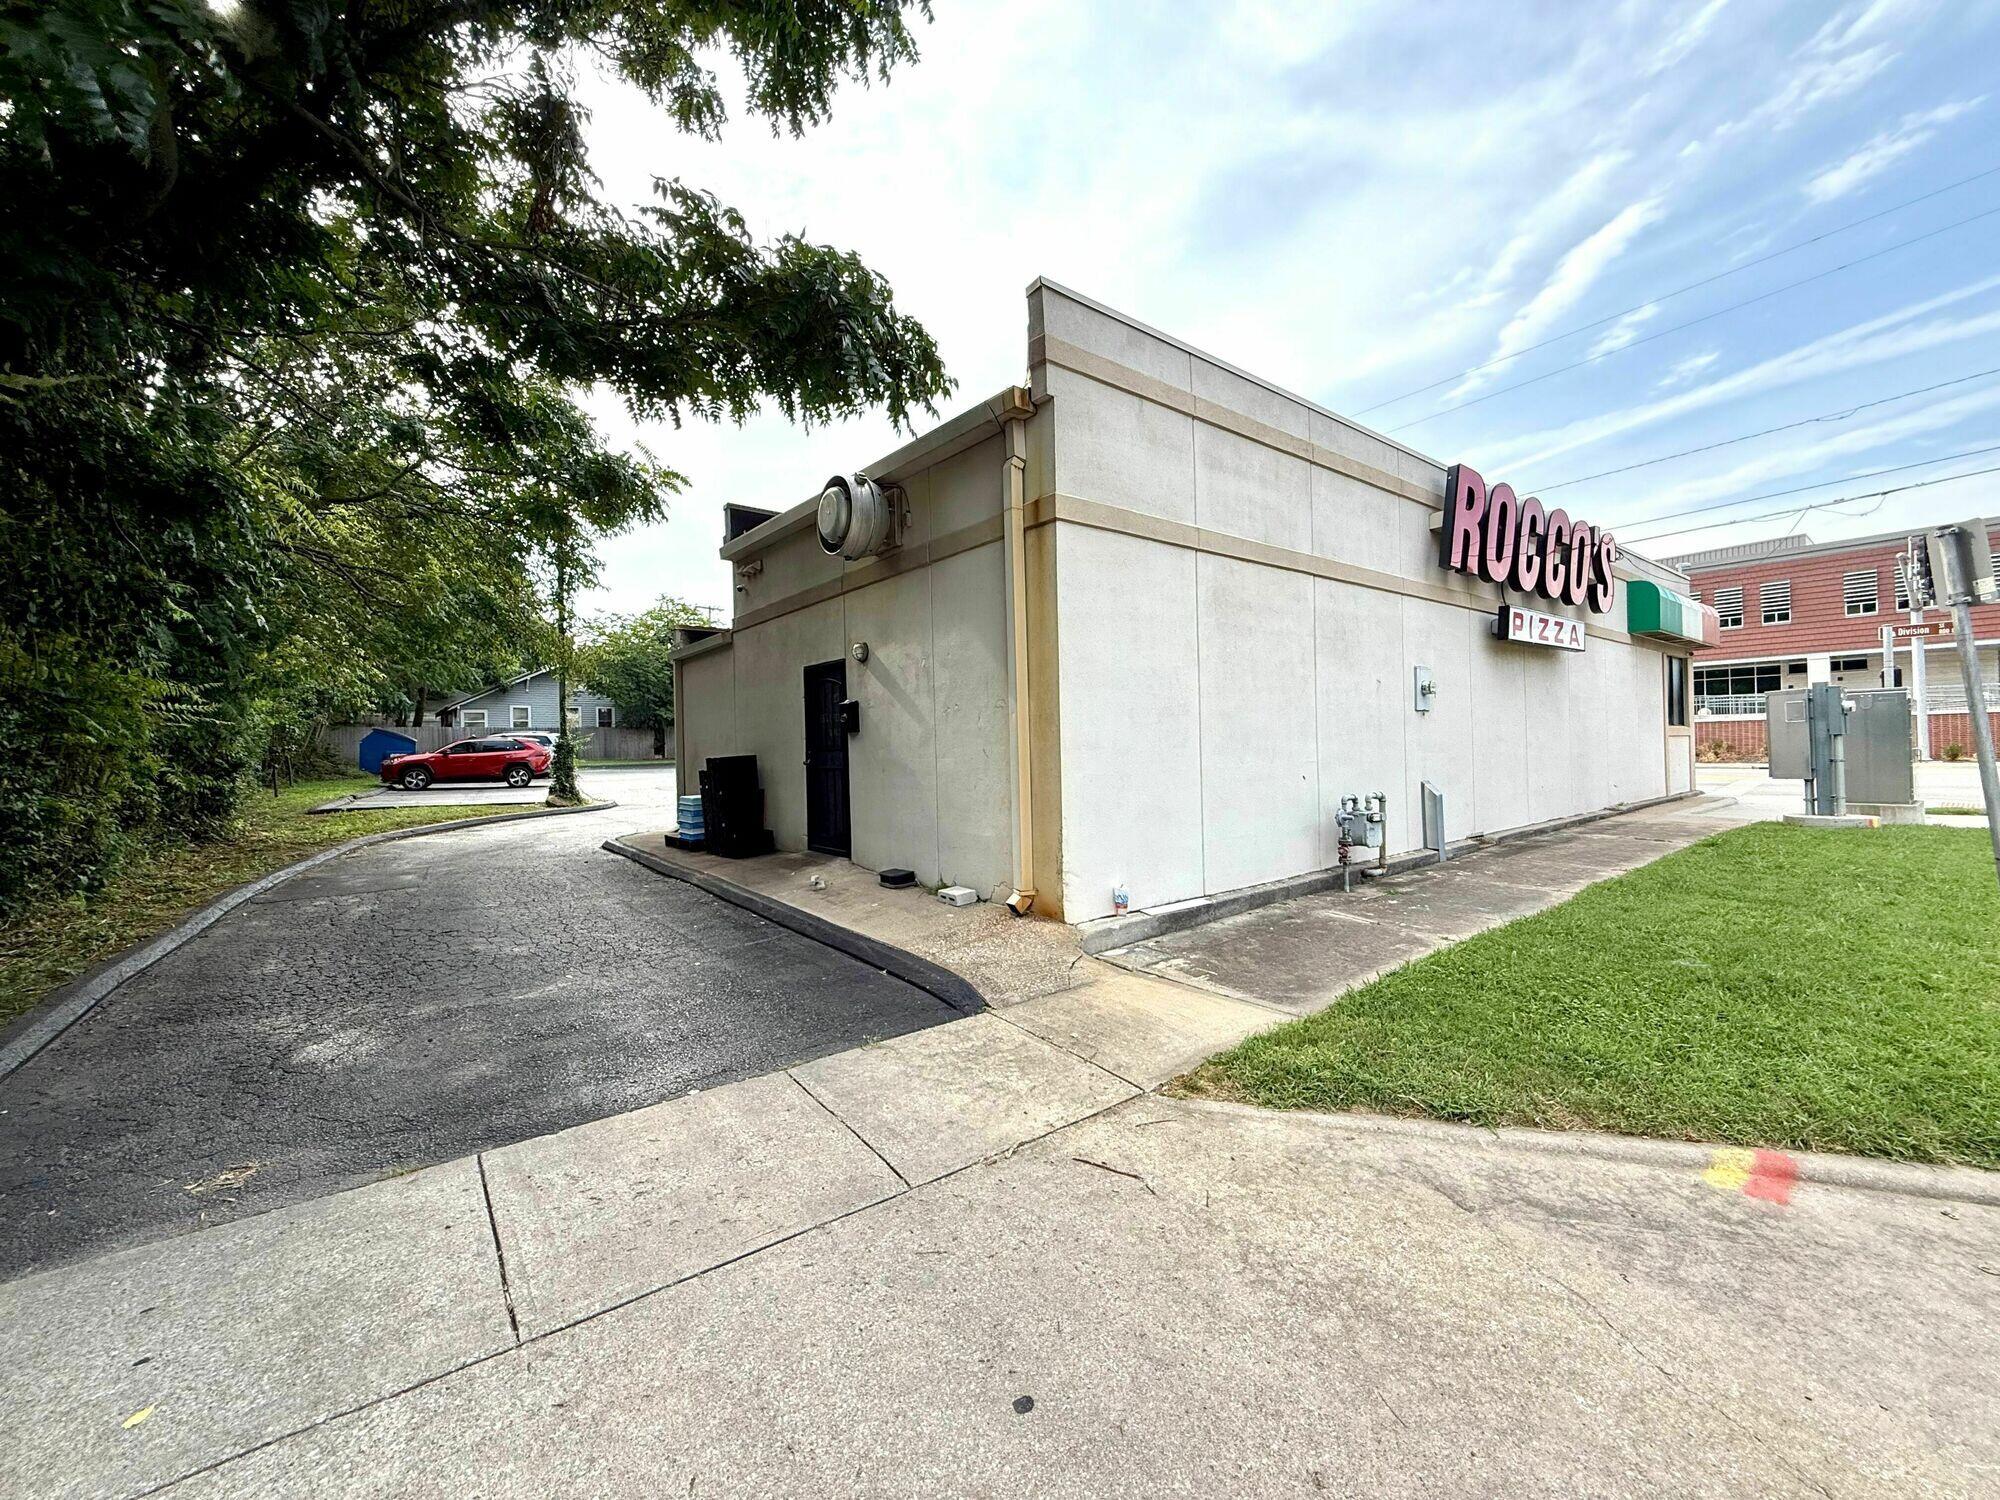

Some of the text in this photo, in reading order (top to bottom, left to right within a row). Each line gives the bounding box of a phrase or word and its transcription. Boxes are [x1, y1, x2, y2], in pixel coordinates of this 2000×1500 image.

[1444, 463, 1616, 613] ROCCO'S
[1512, 611, 1581, 647] PIZZA
[1898, 627, 1930, 636] Division
